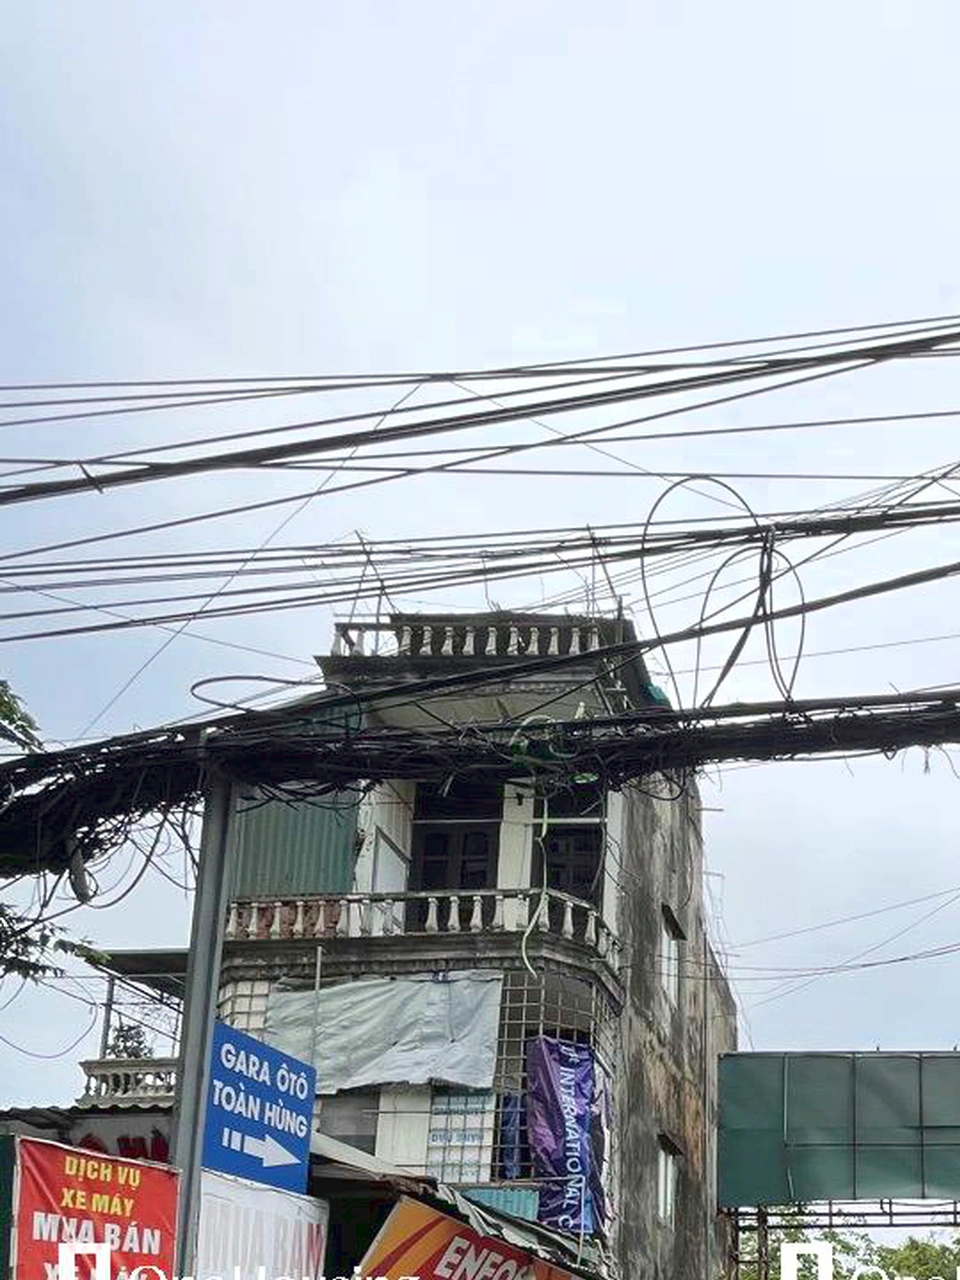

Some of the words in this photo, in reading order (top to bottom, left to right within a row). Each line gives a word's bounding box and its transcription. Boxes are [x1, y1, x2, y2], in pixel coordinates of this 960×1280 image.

[221, 1043, 271, 1086] GARA
[277, 1063, 308, 1100] ÔTÔ
[213, 1079, 260, 1121] TOÀN
[264, 1099, 308, 1138] HÙNG
[65, 1156, 111, 1182] DỊCH
[118, 1169, 142, 1191] VỤ
[60, 1188, 87, 1210] XE
[91, 1192, 135, 1218] MÁY
[104, 1221, 162, 1256] BÁN
